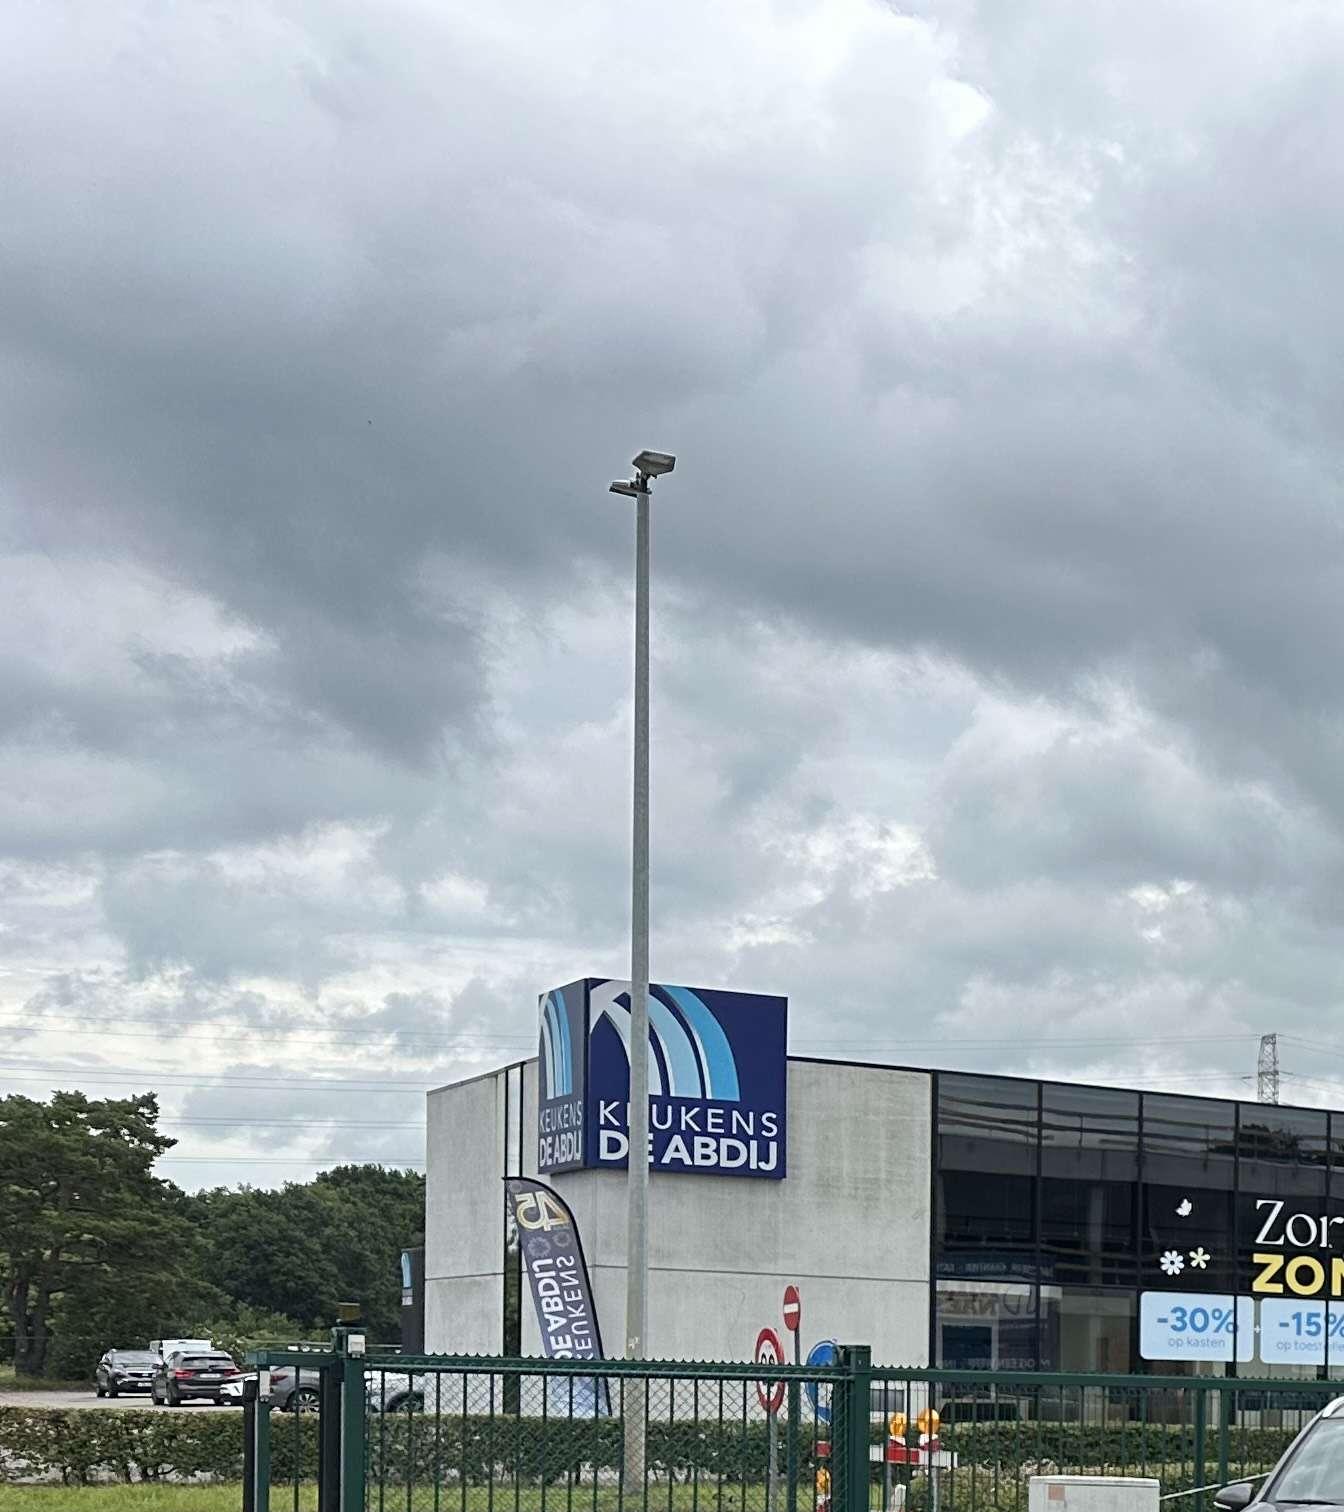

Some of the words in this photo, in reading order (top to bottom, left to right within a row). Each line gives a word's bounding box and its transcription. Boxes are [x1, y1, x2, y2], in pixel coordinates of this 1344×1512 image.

[539, 1101, 583, 1133] KEUKENS
[600, 1100, 779, 1138] KUKENS
[539, 1137, 553, 1167] DE
[553, 1129, 583, 1163] ABDIJ
[661, 1134, 778, 1171] ABDIJ
[1157, 1306, 1238, 1334] -30%
